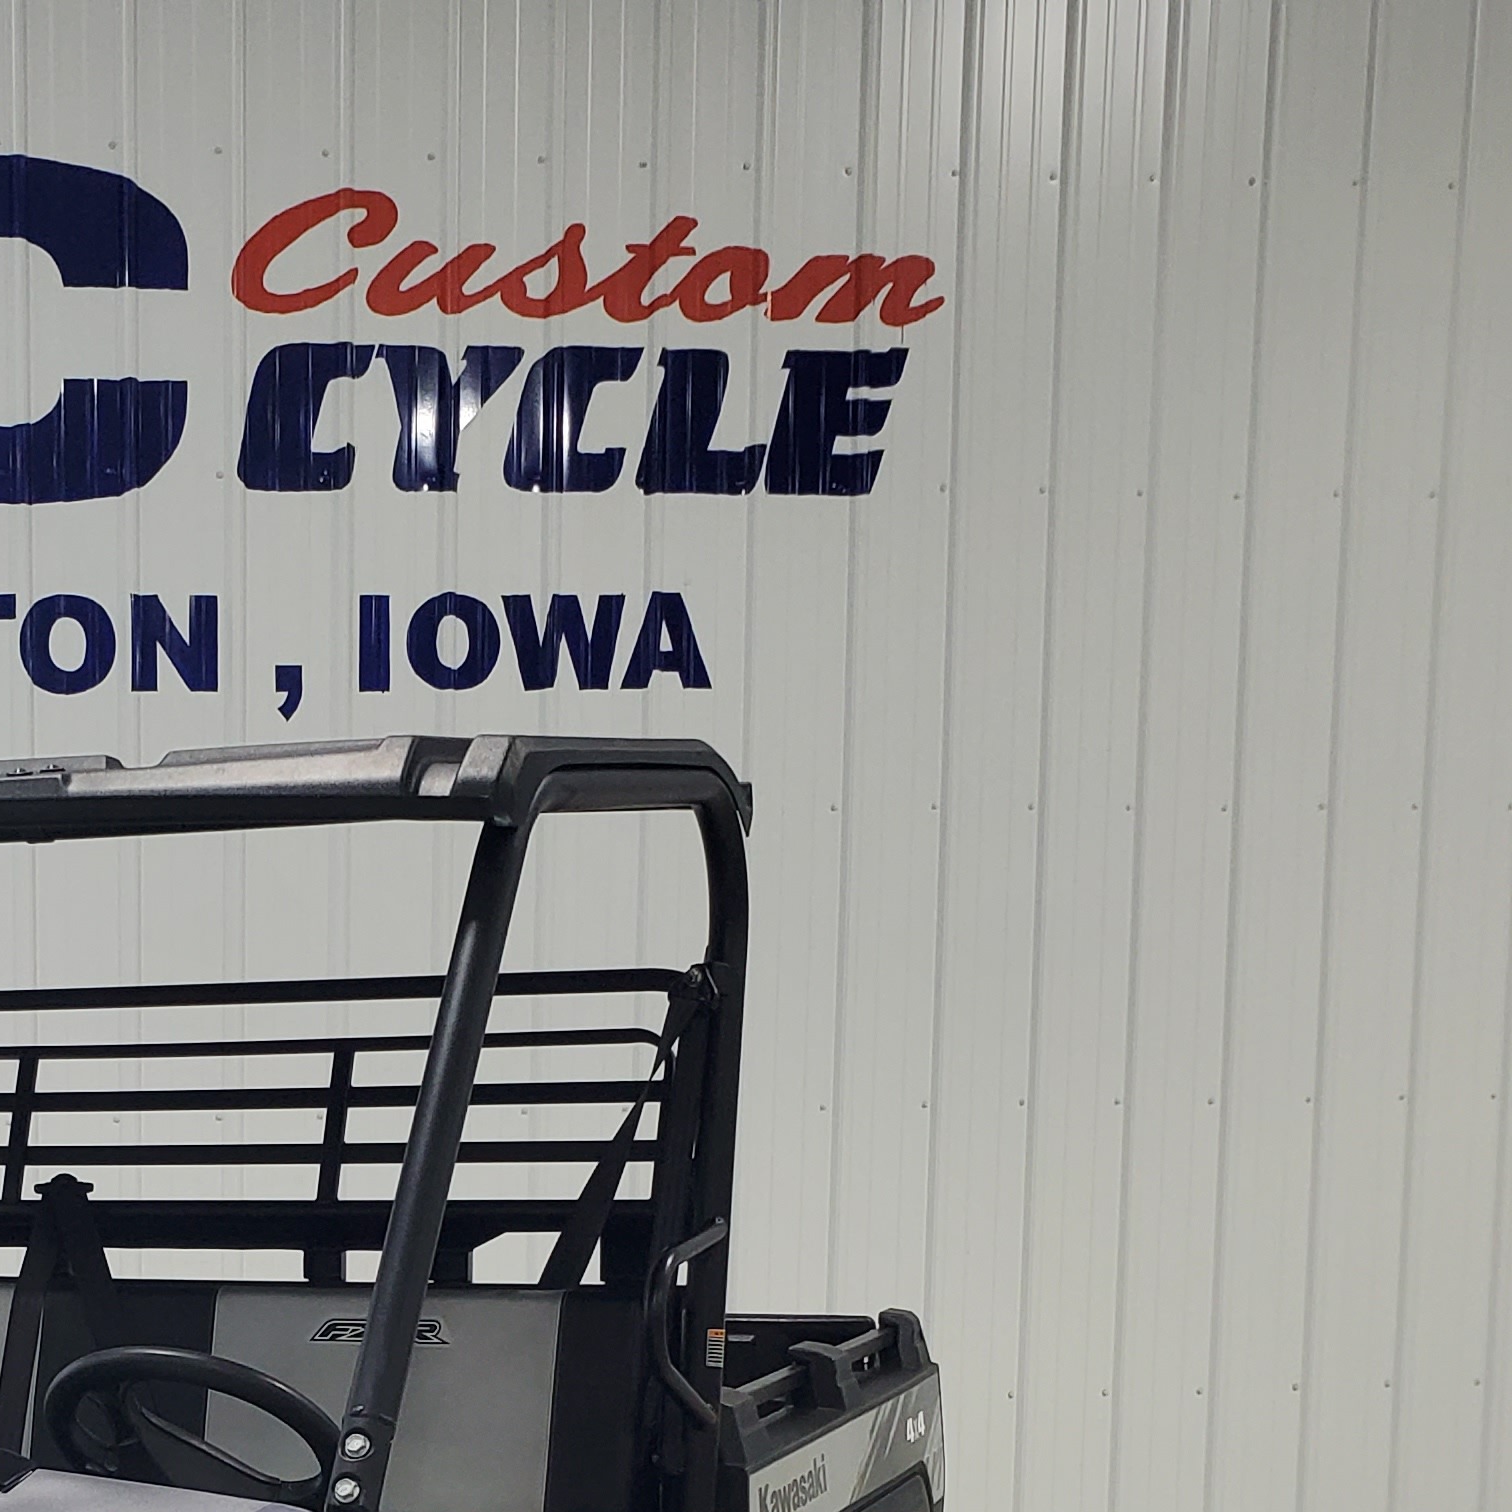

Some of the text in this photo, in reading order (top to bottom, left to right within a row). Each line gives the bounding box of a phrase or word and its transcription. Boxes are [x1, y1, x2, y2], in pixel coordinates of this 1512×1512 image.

[231, 187, 945, 326] Custom
[236, 342, 910, 496] CYCLE
[359, 591, 713, 693] IOWA
